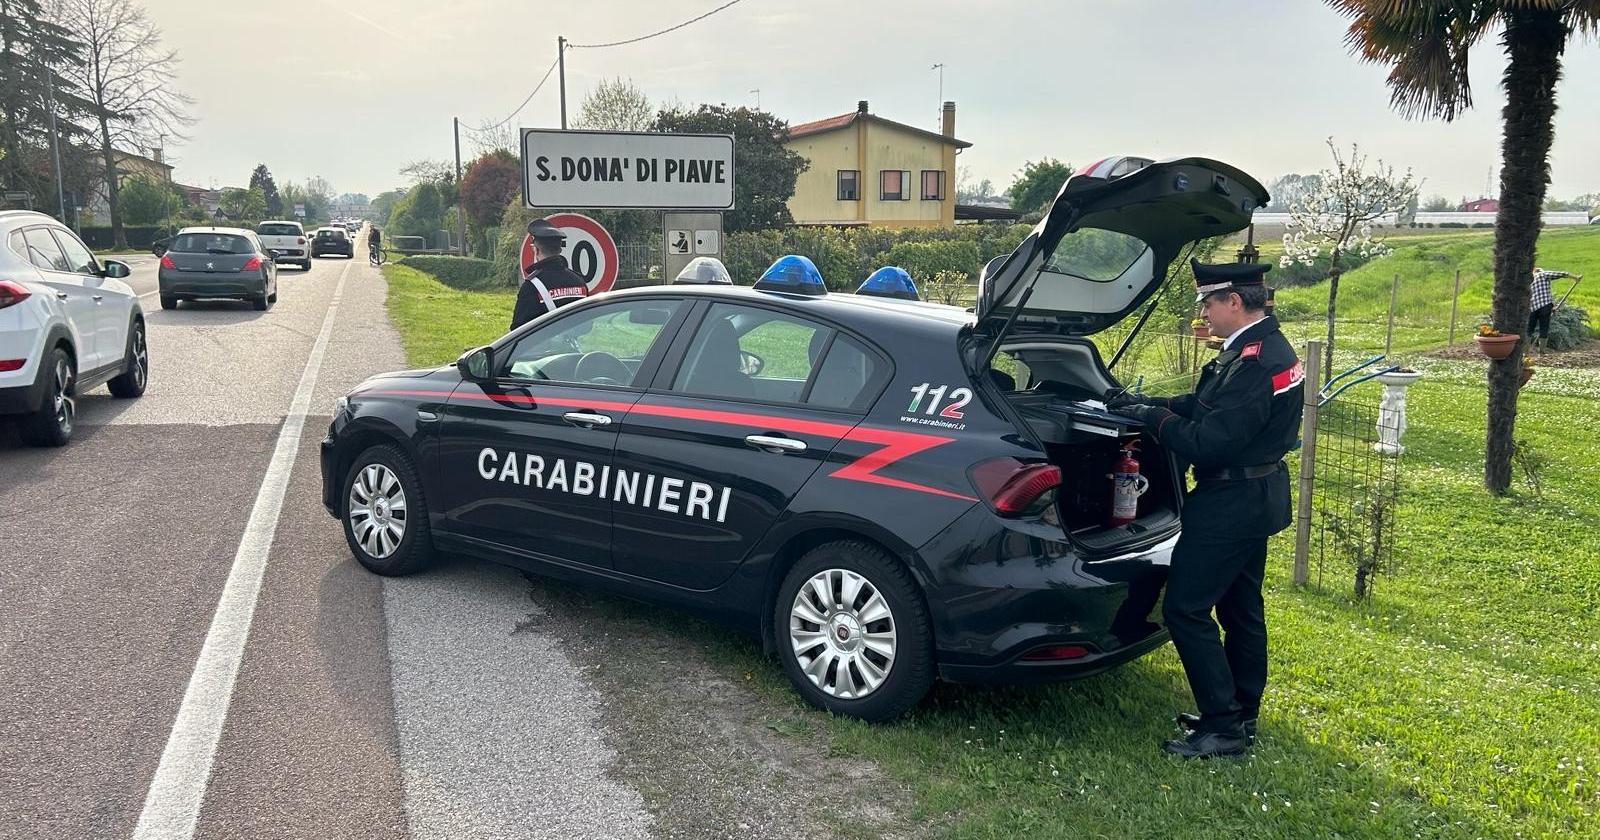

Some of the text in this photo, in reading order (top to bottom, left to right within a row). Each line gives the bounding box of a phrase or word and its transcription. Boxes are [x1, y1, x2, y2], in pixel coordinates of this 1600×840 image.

[536, 156, 726, 184] S. DONA' DI PIAVE
[561, 240, 597, 283] 0
[908, 383, 973, 419] 112
[900, 415, 966, 431] www.carabinieri.it
[478, 447, 732, 523] CARABINIERI
